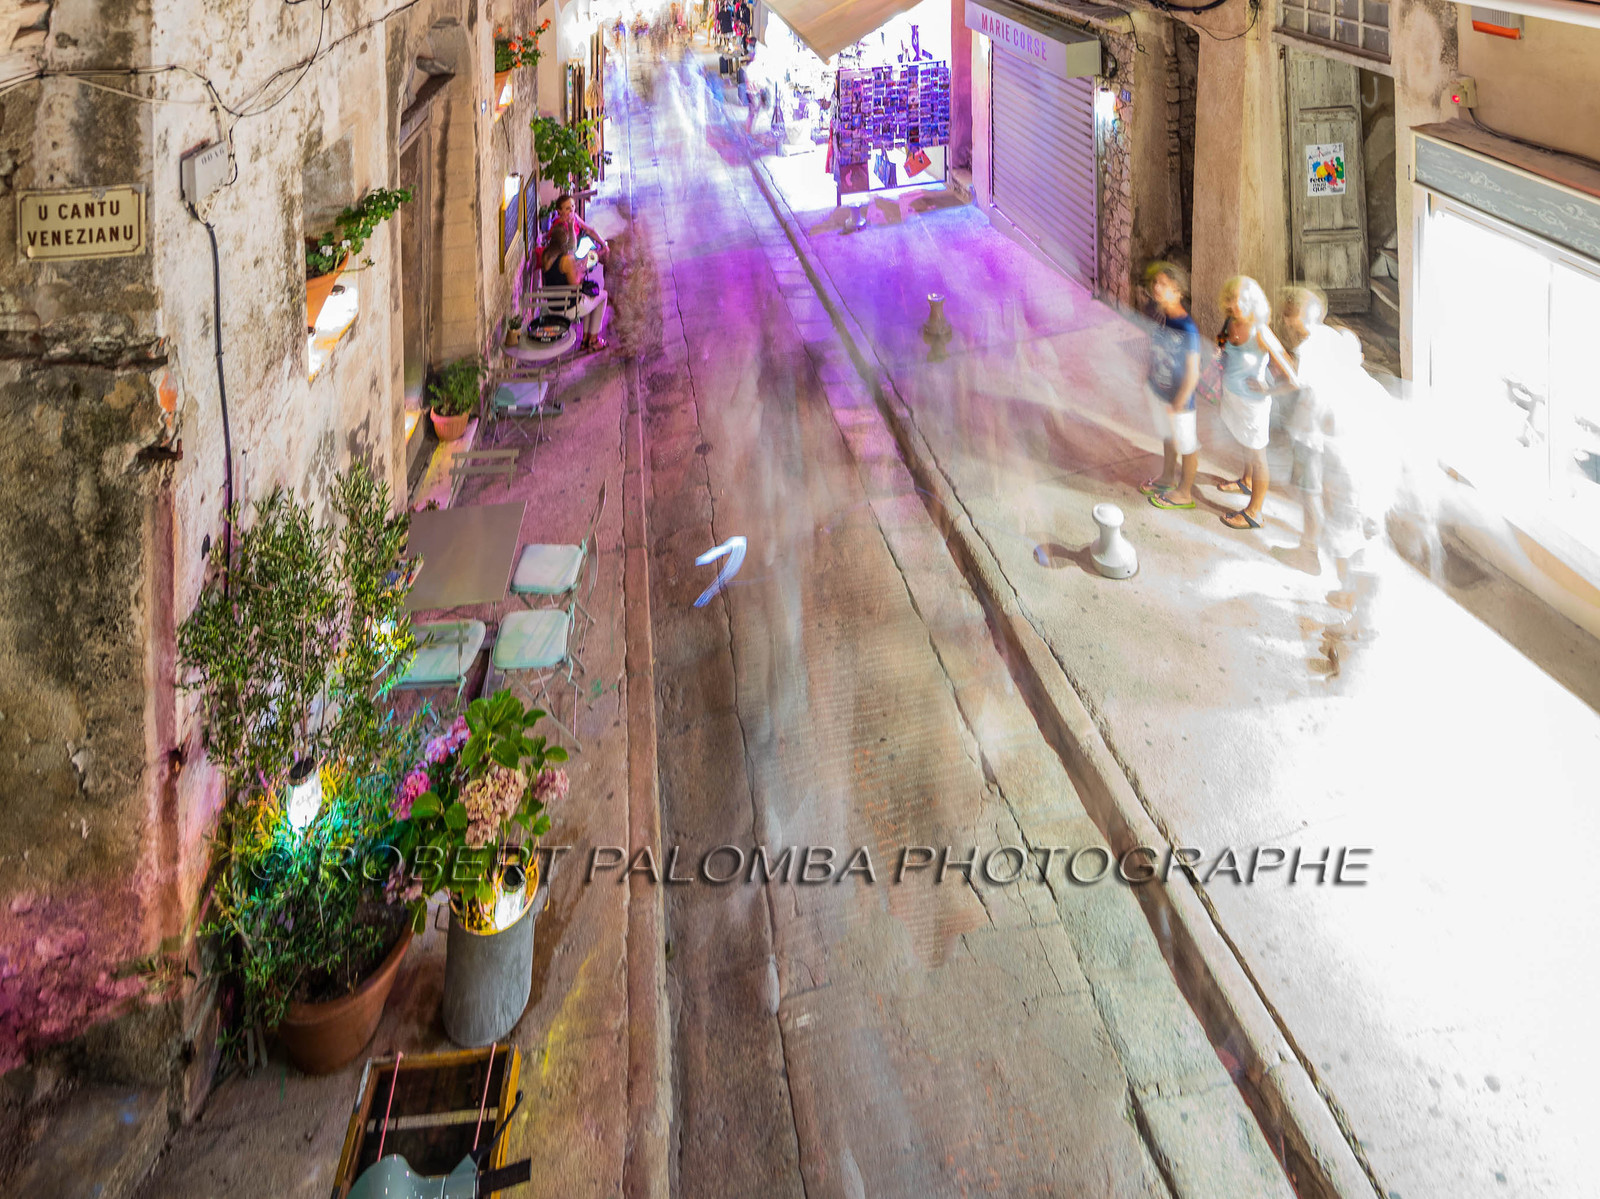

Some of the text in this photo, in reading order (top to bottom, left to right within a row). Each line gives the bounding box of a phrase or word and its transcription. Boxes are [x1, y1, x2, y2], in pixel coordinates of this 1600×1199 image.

[981, 12, 1048, 62] MARIE CORSE
[38, 200, 120, 221] U CANTU
[27, 224, 133, 247] VENEZIANU
